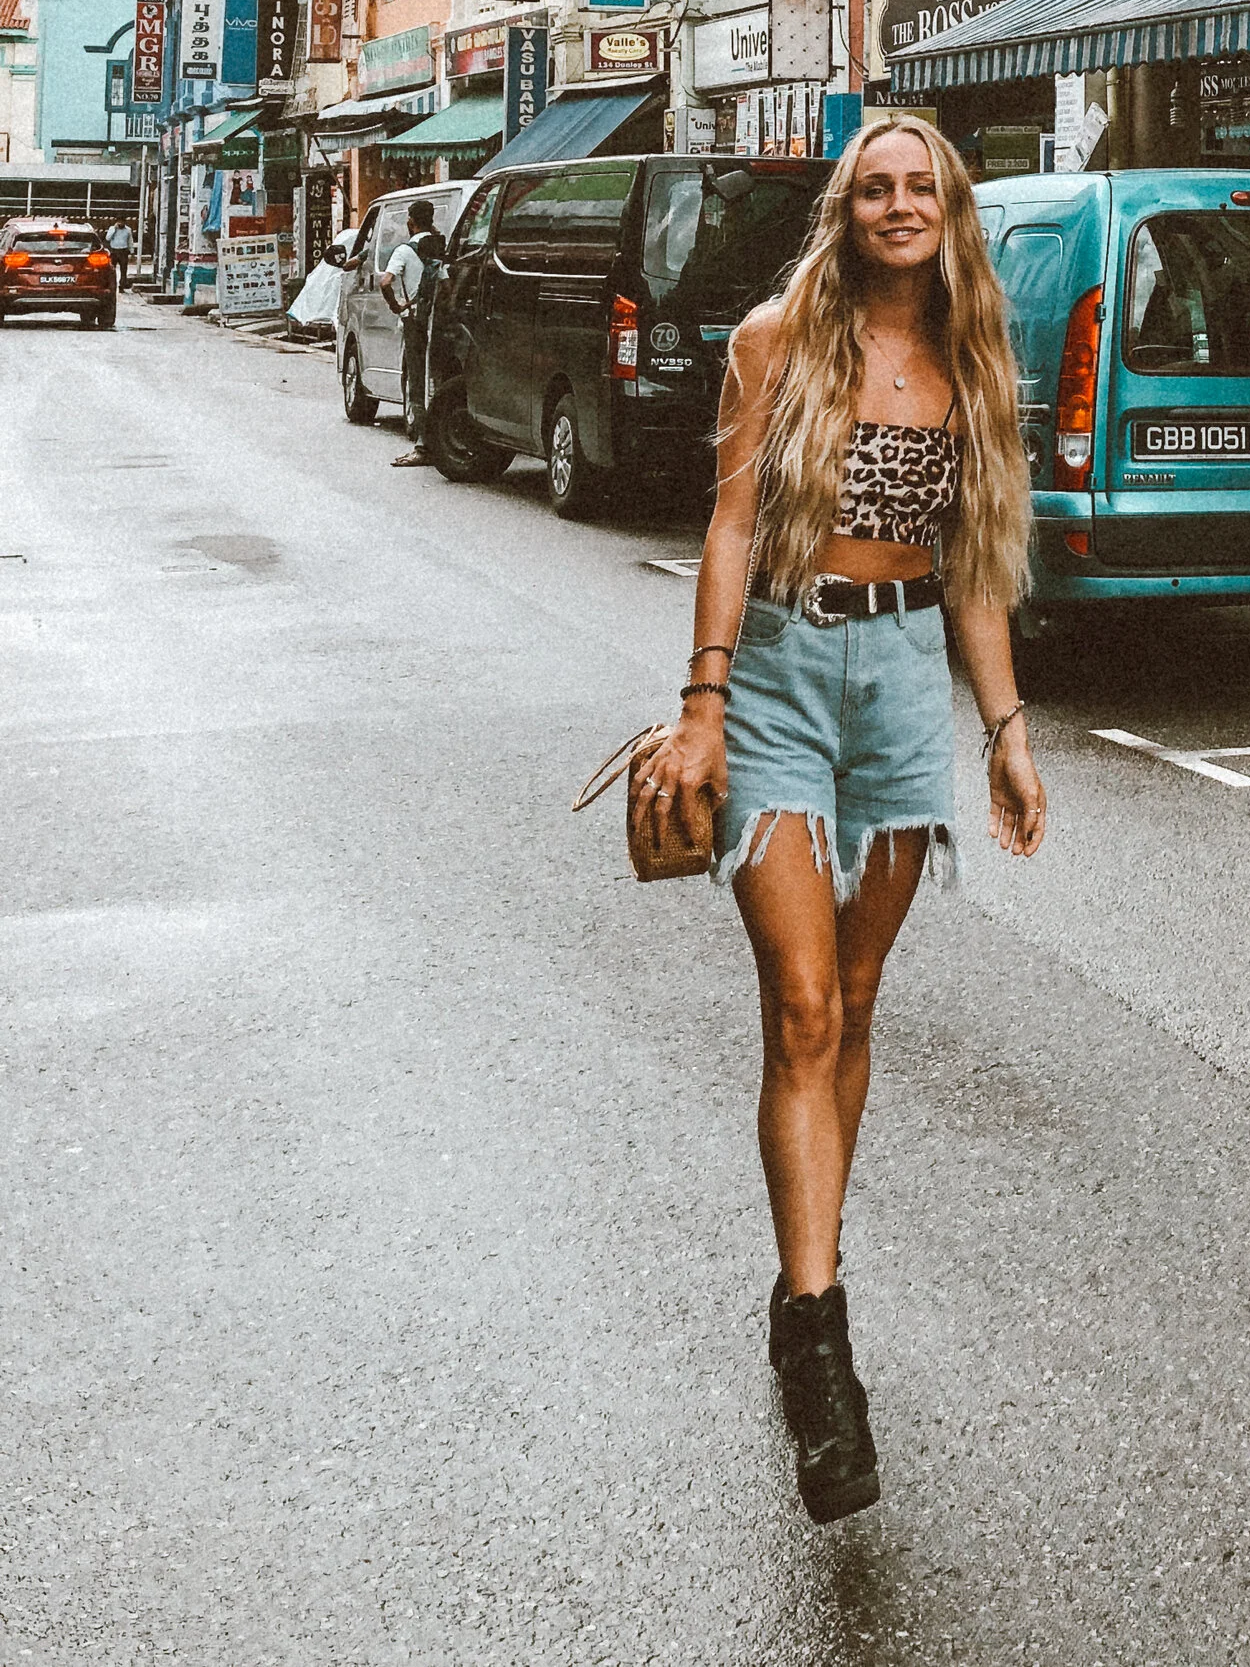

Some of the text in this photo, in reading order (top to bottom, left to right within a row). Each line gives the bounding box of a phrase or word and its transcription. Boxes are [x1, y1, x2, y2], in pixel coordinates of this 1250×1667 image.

[225, 17, 258, 27] vivo
[891, 20, 915, 46] THE
[137, 18, 162, 73] MGR
[605, 36, 647, 48] Valle's
[519, 29, 536, 76] VASU
[598, 61, 613, 69] 134
[614, 61, 642, 70] Dunlop
[519, 80, 535, 133] BANG
[655, 328, 676, 342] 70
[650, 357, 693, 366] NV350
[1123, 473, 1177, 485] RENAULT
